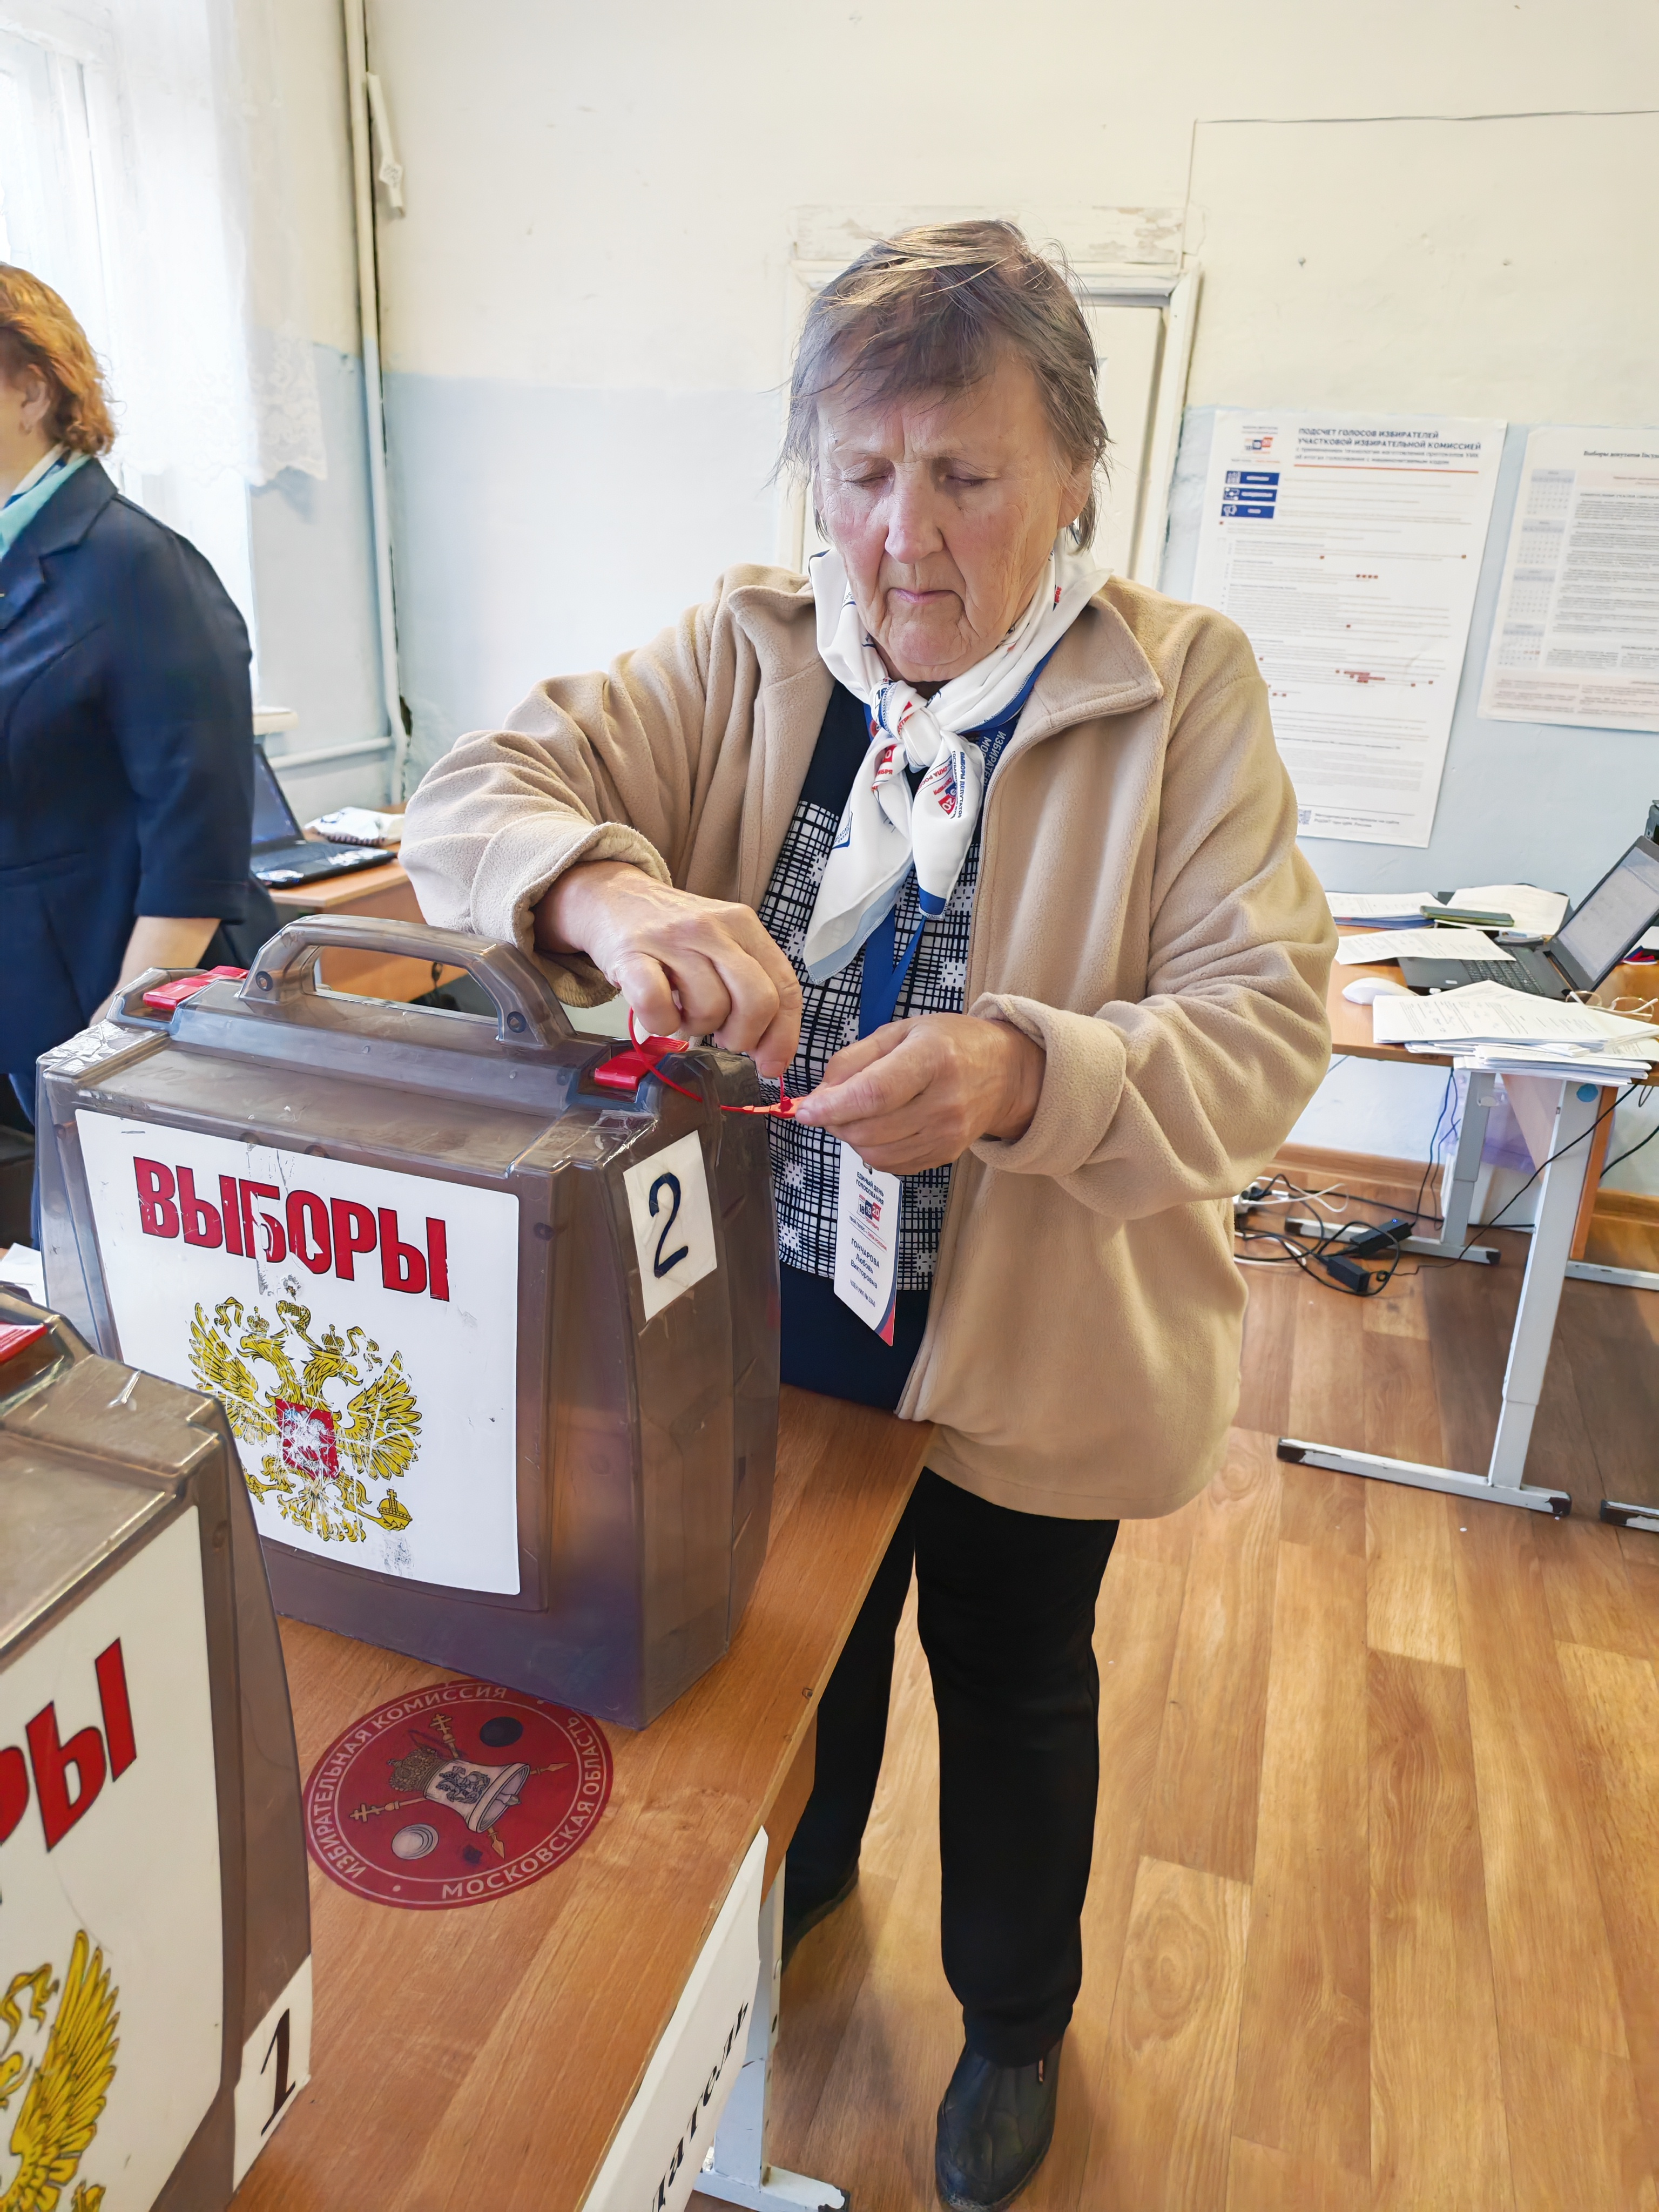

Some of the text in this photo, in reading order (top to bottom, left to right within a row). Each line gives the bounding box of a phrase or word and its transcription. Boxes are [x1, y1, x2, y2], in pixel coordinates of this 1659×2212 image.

[1298, 428, 1336, 436] ПОДСЧЕТ
[1379, 430, 1439, 439] ИЗБИРАТЕЛЕЙ
[1298, 437, 1481, 450] УЧАСТКОВОЙ ИЗБИРАТЕЛЬНОЙ КОМИССИЕЙ
[933, 766, 948, 777] СИЛА
[856, 1179, 885, 1205] ГОЛОСОВАНИЯ
[857, 1171, 884, 1197] ЕДИНЫЙ ДЕНЬ
[649, 1171, 689, 1279] 2
[859, 1204, 879, 1218] 18 19 20
[133, 1156, 450, 1302] ВЫБОРЫ
[851, 1238, 880, 1269] ГОНЧАРОВА
[856, 1253, 873, 1274] Любовь
[851, 1259, 878, 1289] Викторовна
[314, 1686, 507, 1879] ИЗБИРАТЕЛЬНАЯ КОМИССИЯ
[442, 1716, 601, 1900] МОСКОВСКАЯ ОБЛАСТЬ
[260, 2007, 296, 2137] 1
